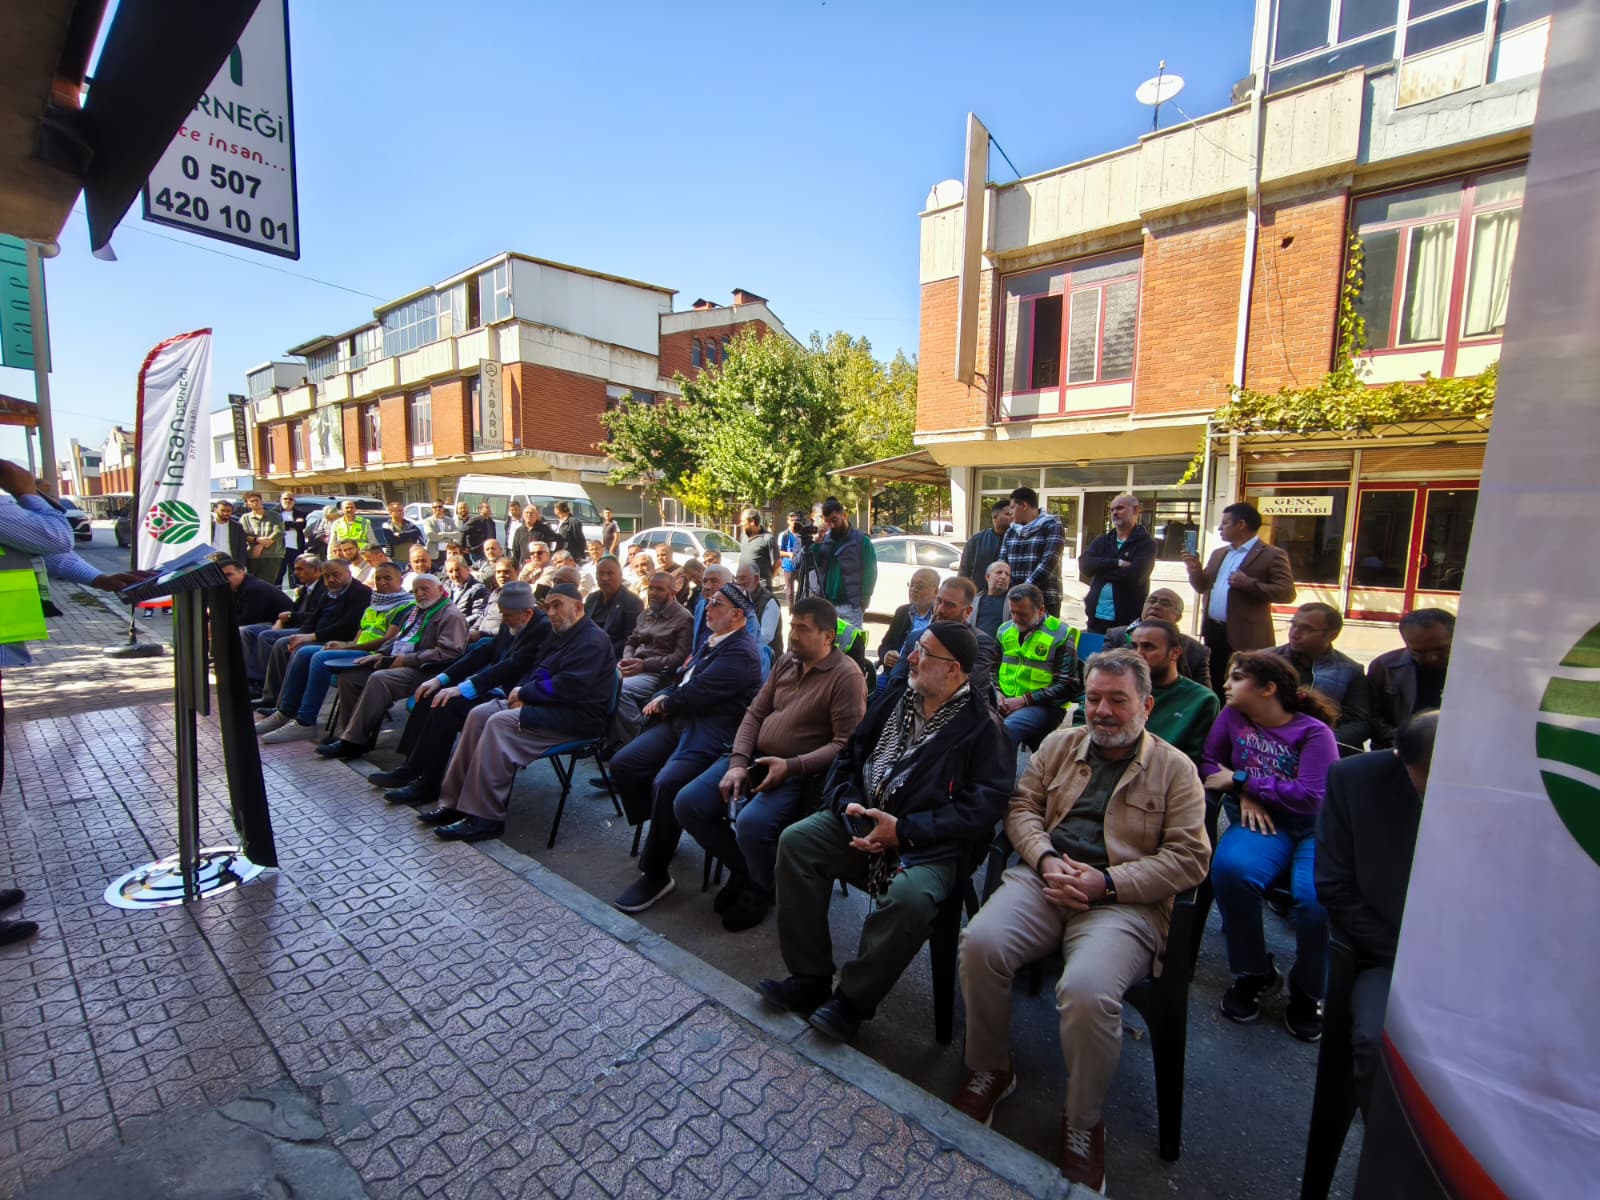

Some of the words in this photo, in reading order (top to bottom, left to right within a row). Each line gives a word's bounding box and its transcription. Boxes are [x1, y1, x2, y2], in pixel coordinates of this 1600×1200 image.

[182, 155, 200, 181] 0
[210, 163, 262, 199] 507
[155, 187, 209, 221] 420
[219, 204, 251, 234] 10
[260, 216, 288, 245] 01
[487, 378, 497, 439] TABARU
